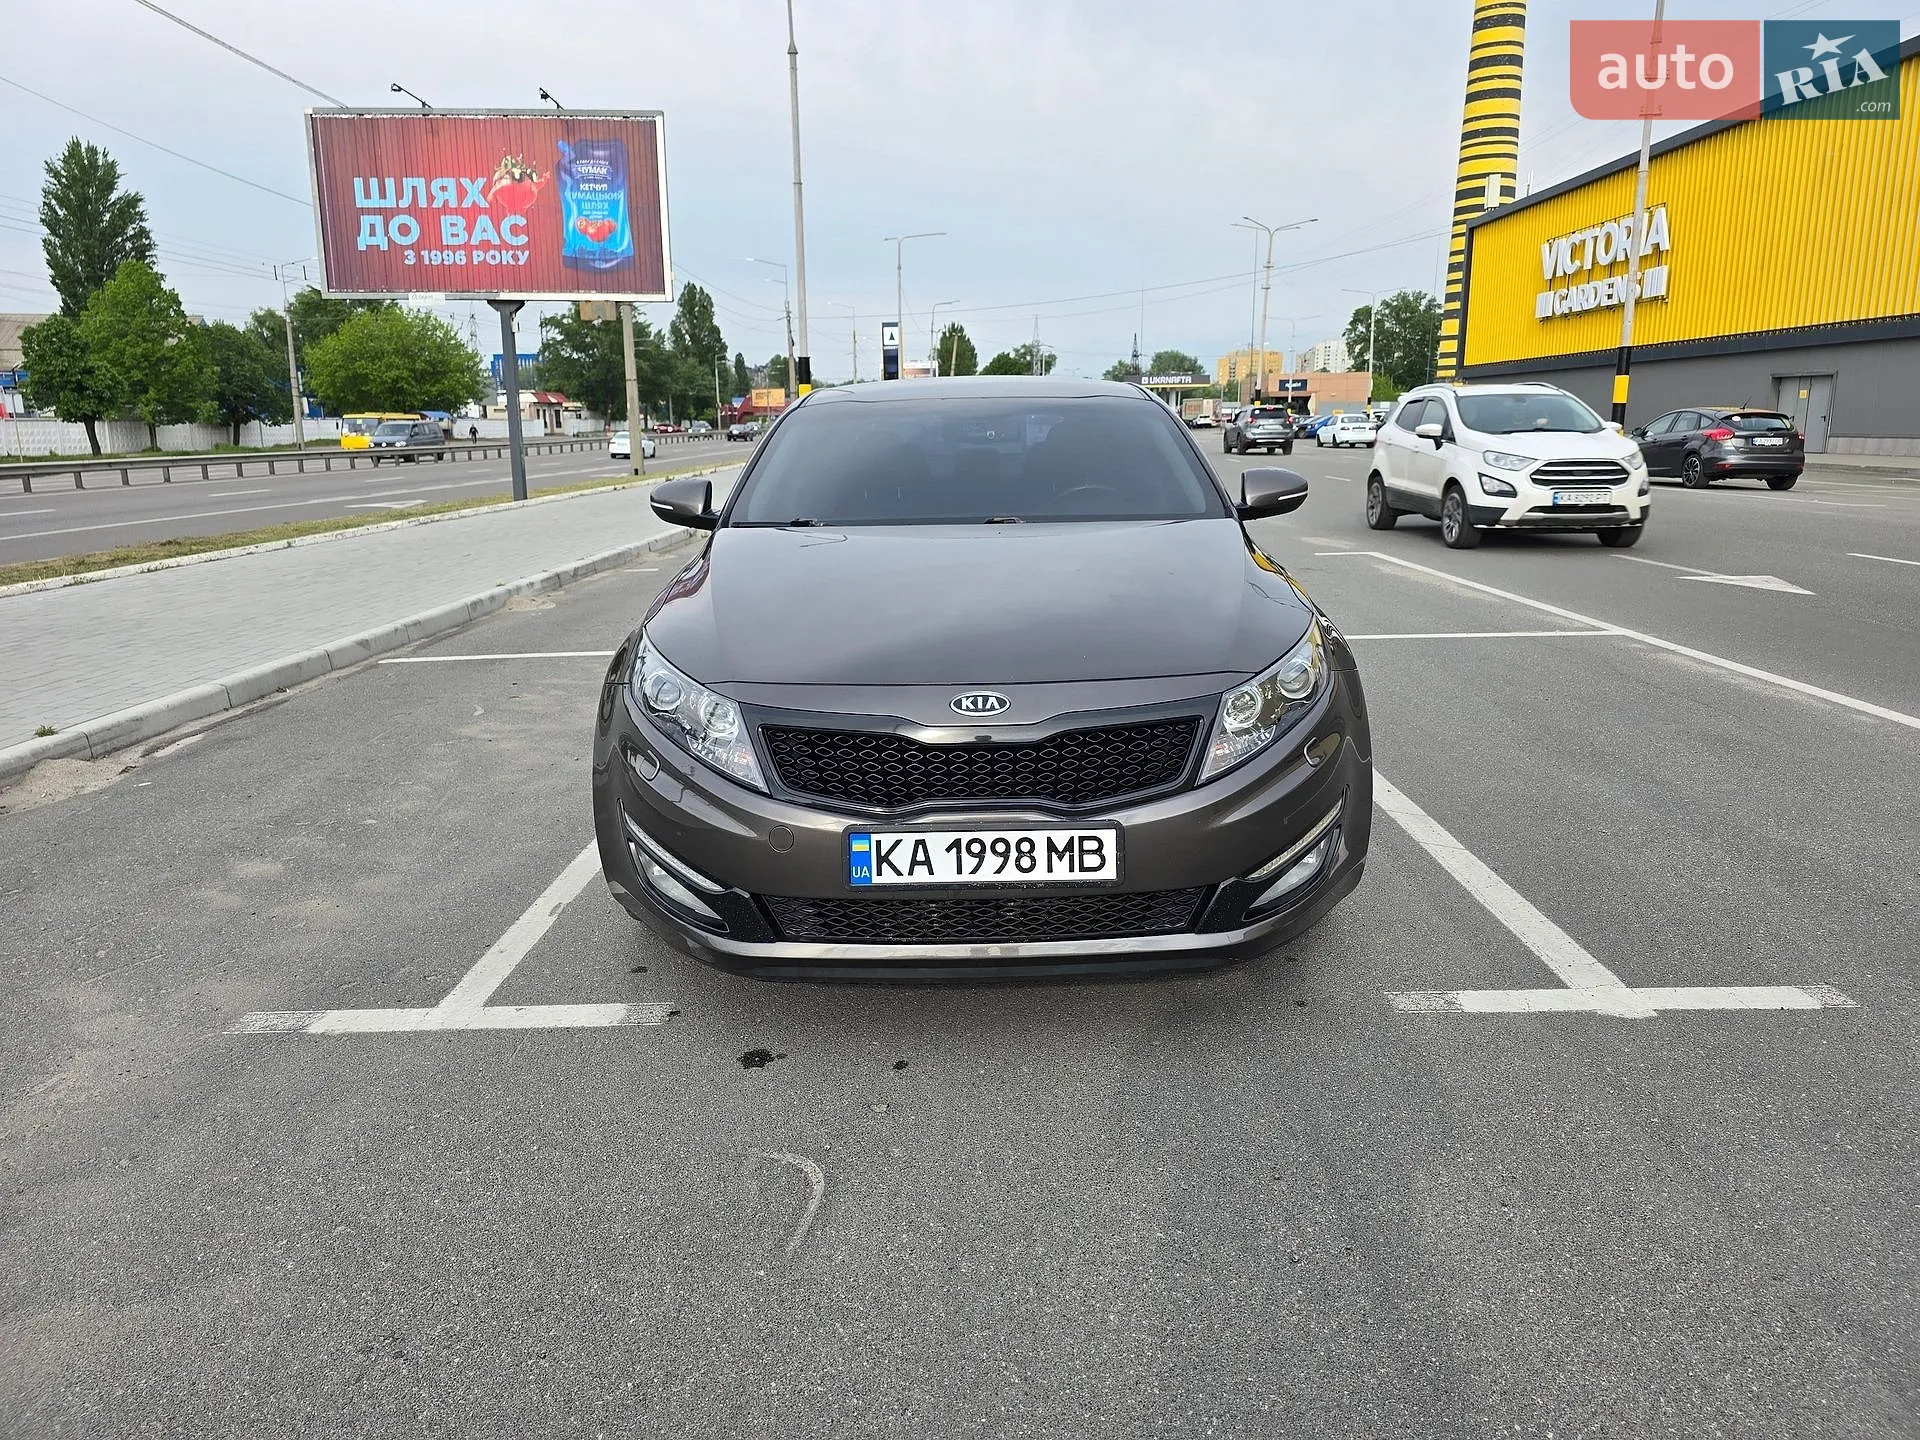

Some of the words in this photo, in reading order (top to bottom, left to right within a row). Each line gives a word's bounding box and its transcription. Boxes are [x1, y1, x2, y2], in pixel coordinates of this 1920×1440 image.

[578, 166, 608, 176] ЧУМАК
[354, 176, 490, 209] ШЛЯХ
[579, 183, 608, 191] КЕТЧУП
[357, 215, 421, 251] ДО
[441, 215, 529, 246] ВАС
[1541, 206, 1671, 280] VICTORIA
[420, 250, 466, 265] 1996
[472, 250, 530, 265] РОКУ
[1149, 376, 1192, 384] UKRNAFTA
[960, 696, 1001, 710] KIA
[852, 865, 870, 878] UA
[875, 838, 935, 877] KA
[945, 836, 1037, 875] 1998
[1046, 835, 1107, 874] MB
